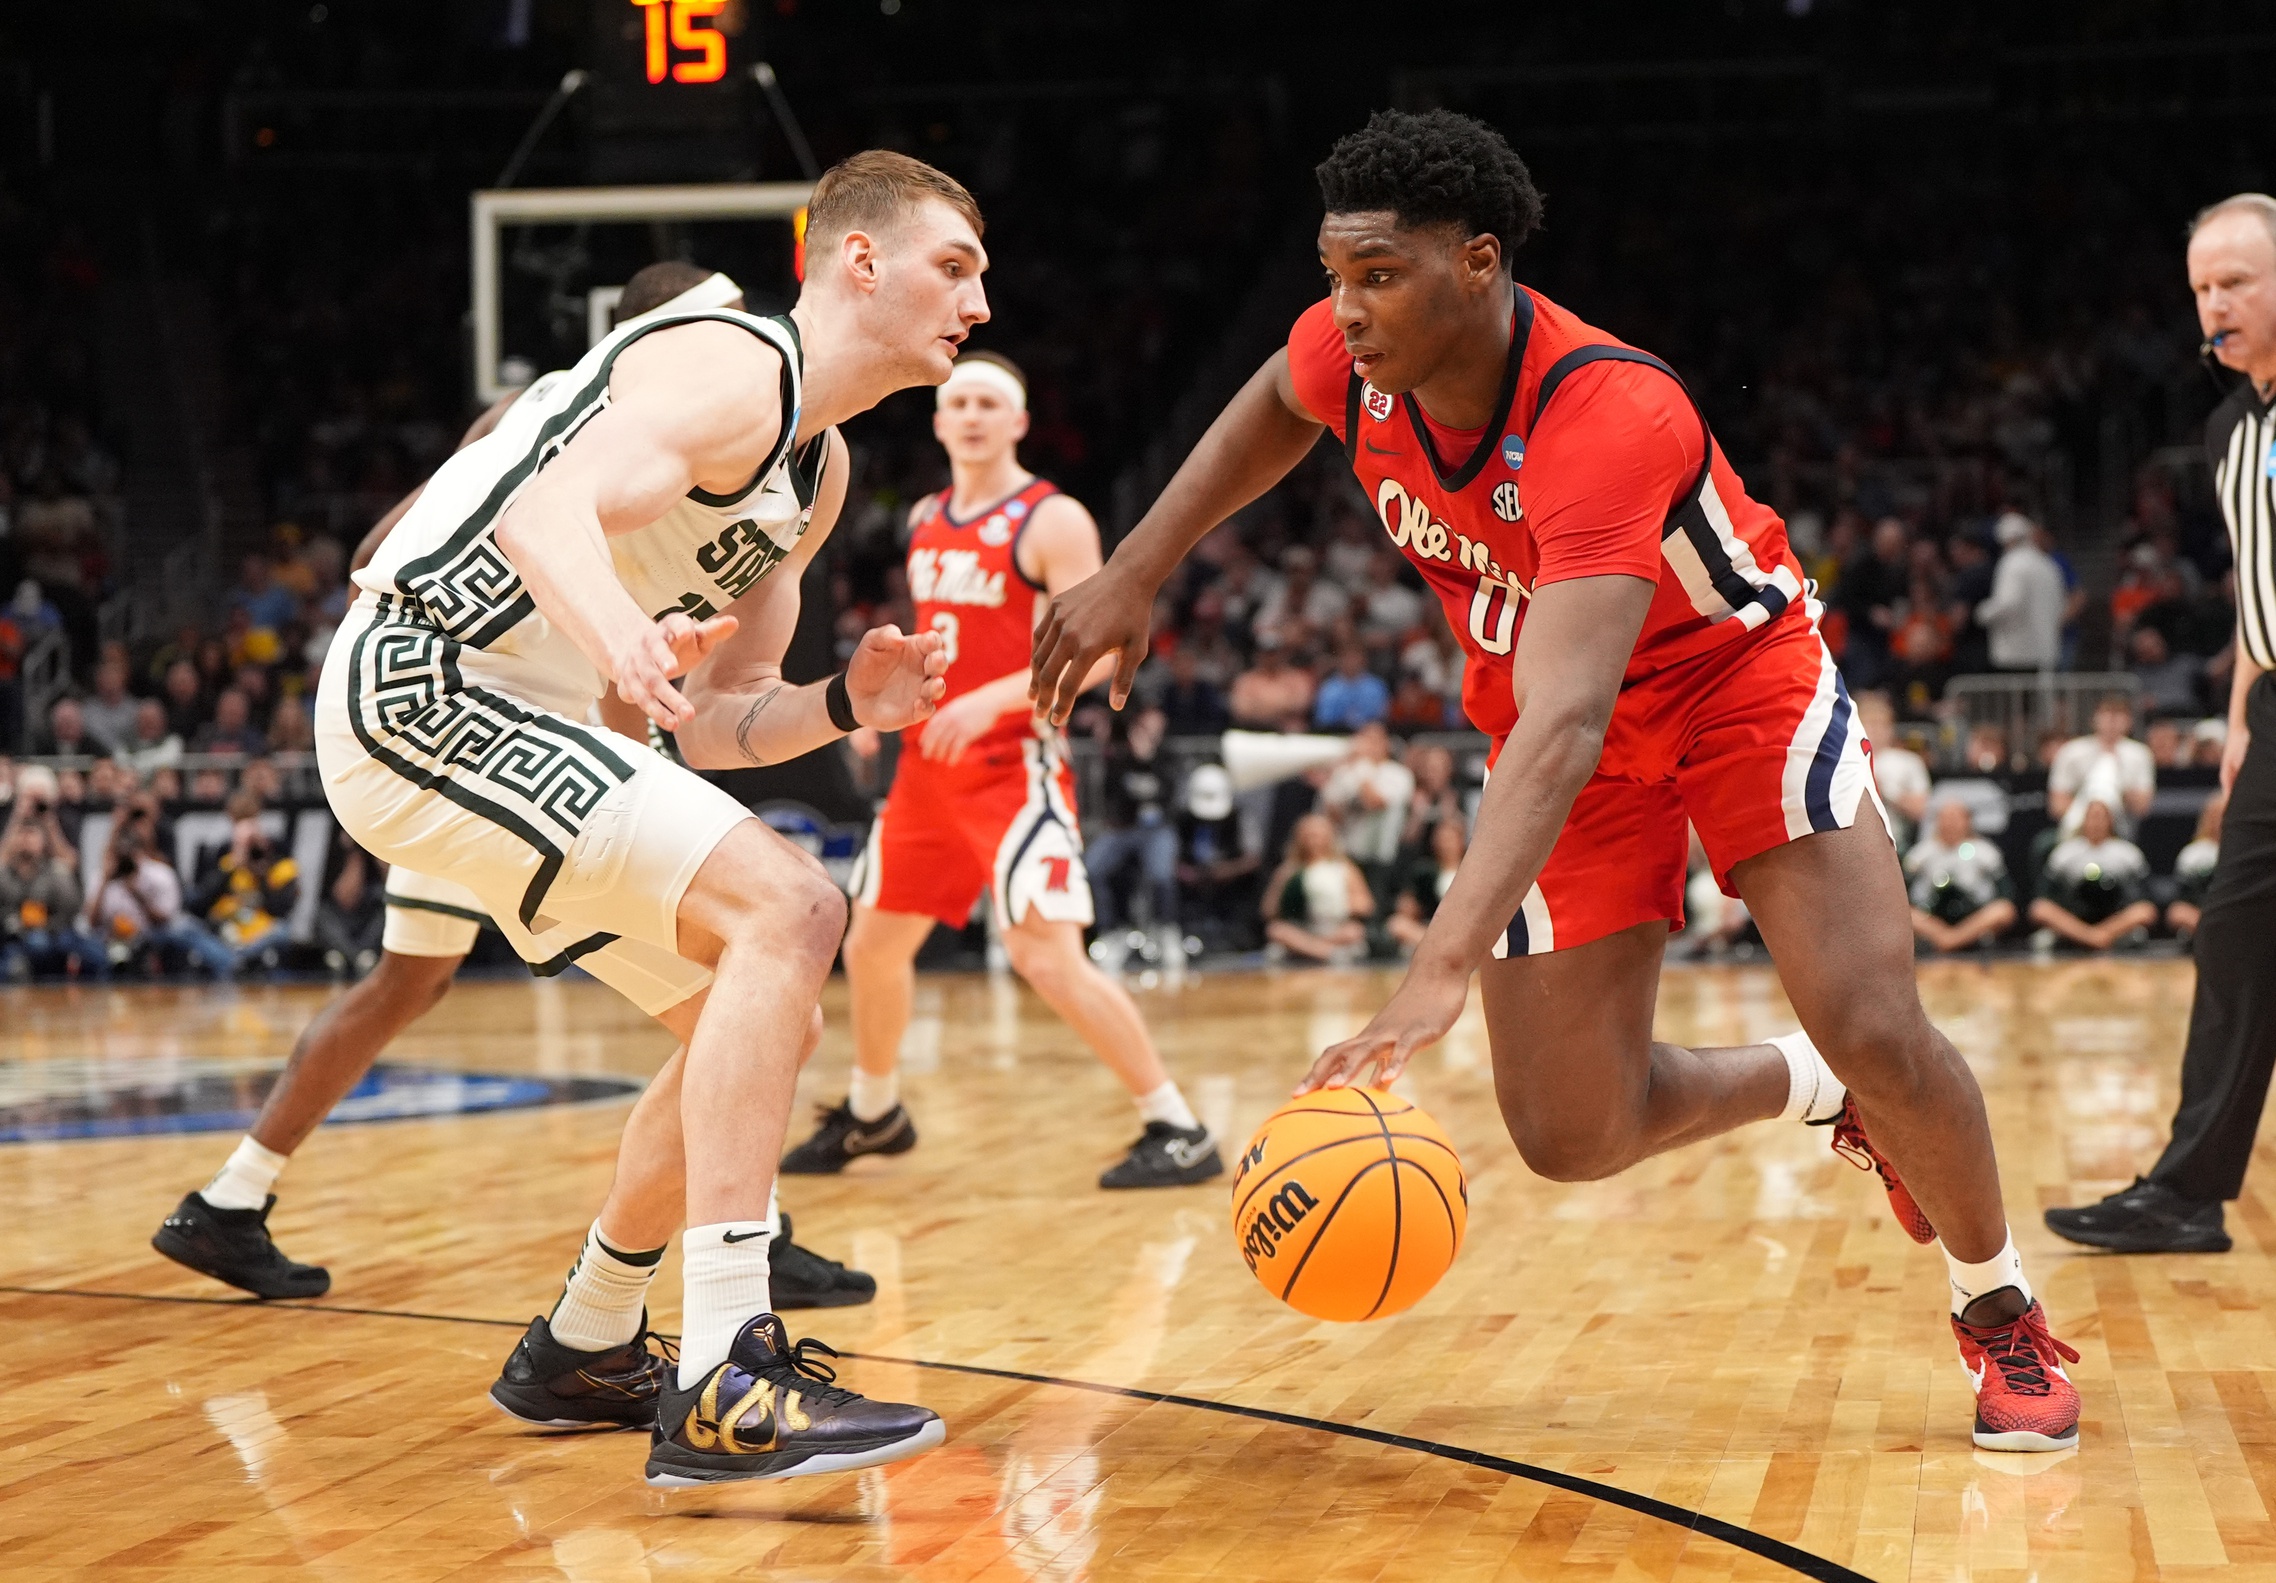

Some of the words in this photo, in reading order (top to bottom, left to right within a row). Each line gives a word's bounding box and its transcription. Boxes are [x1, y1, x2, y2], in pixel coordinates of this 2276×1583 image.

[645, 1, 727, 84] 15
[1369, 391, 1388, 416] 22
[1505, 450, 1524, 463] NCAA
[1378, 478, 1451, 562] Ole
[1436, 516, 1536, 601] Mis
[1469, 575, 1521, 656] 0
[1243, 1181, 1319, 1278] Wilso
